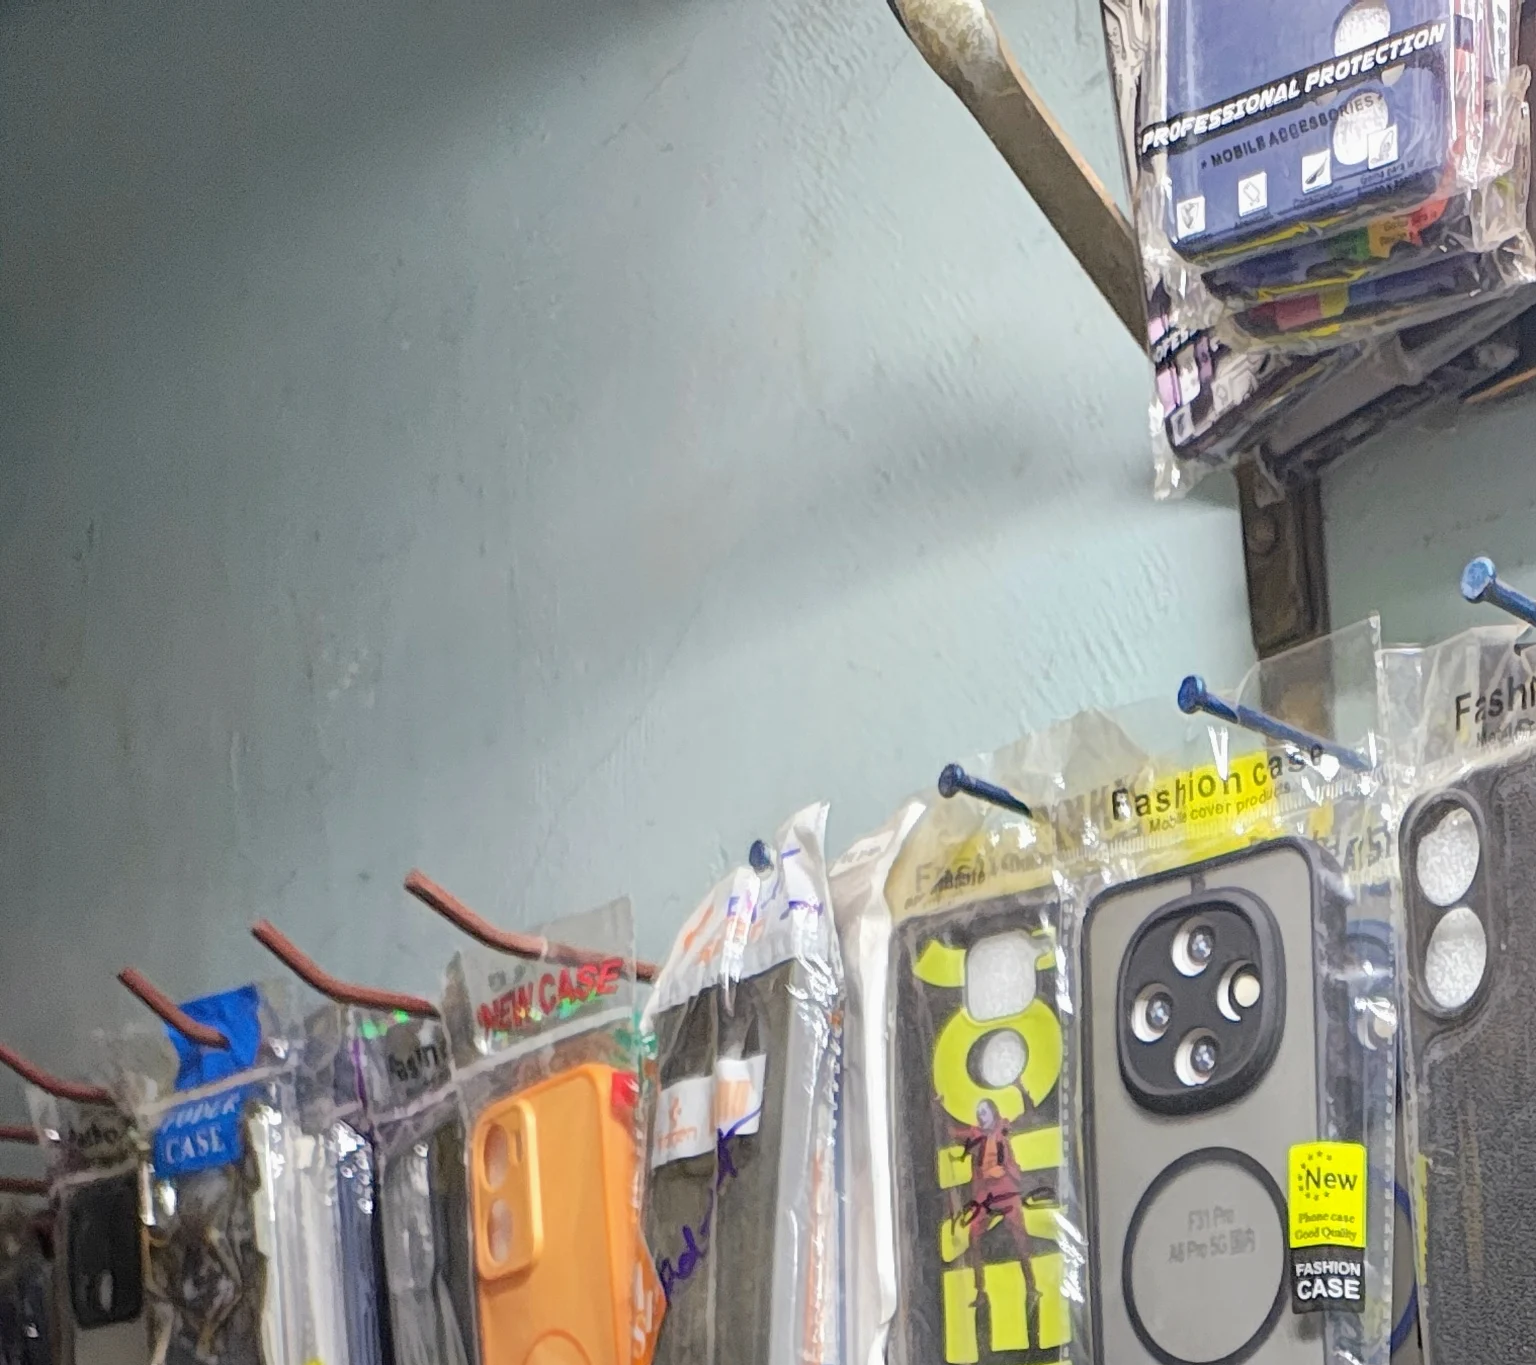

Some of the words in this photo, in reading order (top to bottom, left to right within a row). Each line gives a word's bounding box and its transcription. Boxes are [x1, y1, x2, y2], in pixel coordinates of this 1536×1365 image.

[1141, 77, 1301, 154] PROFESSIONAL
[1303, 20, 1447, 93] PROTECTION
[1210, 134, 1266, 169] MOBILE
[1265, 93, 1375, 147] ACCESSORIES
[1112, 769, 1242, 821] Fashion
[1190, 803, 1231, 821] cover
[537, 958, 624, 1015] CASE
[1305, 1167, 1358, 1191] New
[1298, 1213, 1329, 1224] Phone
[1330, 1214, 1355, 1223] case
[1295, 1227, 1320, 1241] Good
[1321, 1227, 1357, 1242] Quality
[1296, 1261, 1360, 1277] FASHION
[1297, 1278, 1360, 1300] CASE
